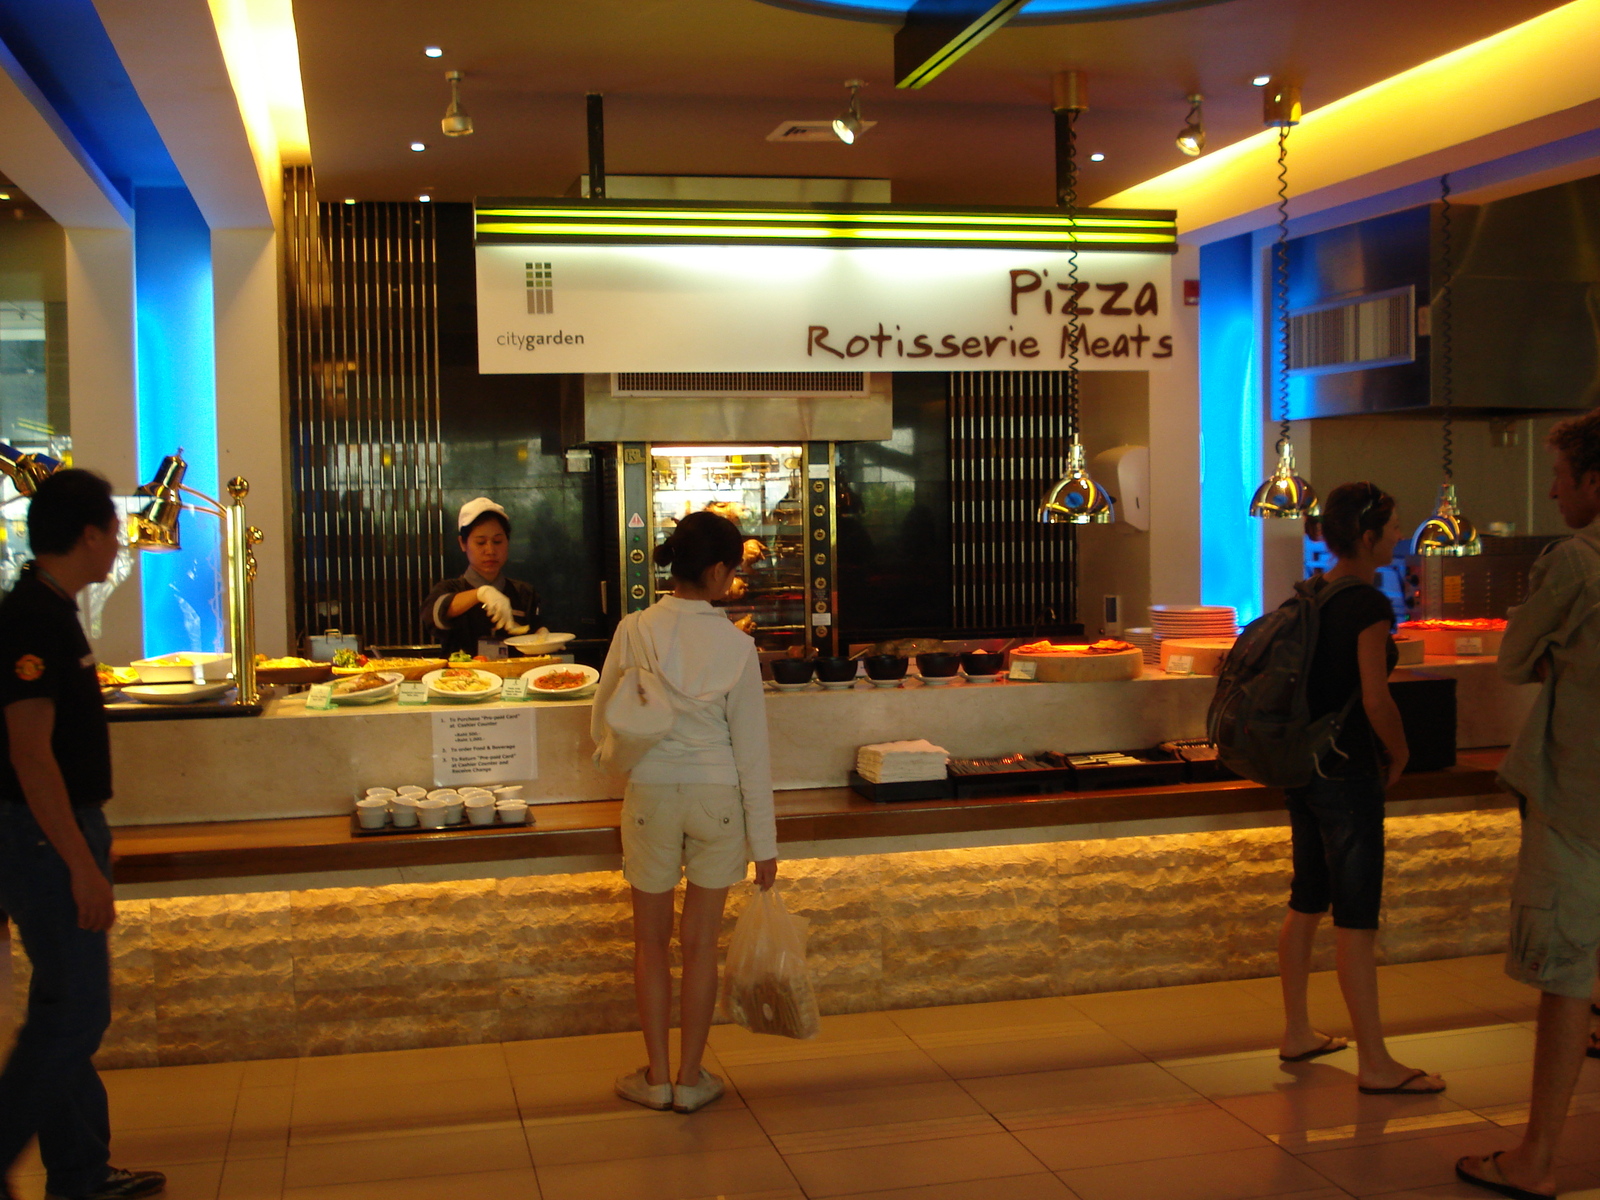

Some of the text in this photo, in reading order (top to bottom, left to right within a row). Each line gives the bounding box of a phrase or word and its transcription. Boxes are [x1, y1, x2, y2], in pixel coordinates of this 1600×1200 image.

[1009, 268, 1158, 316] Pizza
[496, 329, 585, 351] citygarden
[807, 323, 1173, 360] Rotisserie Meats
